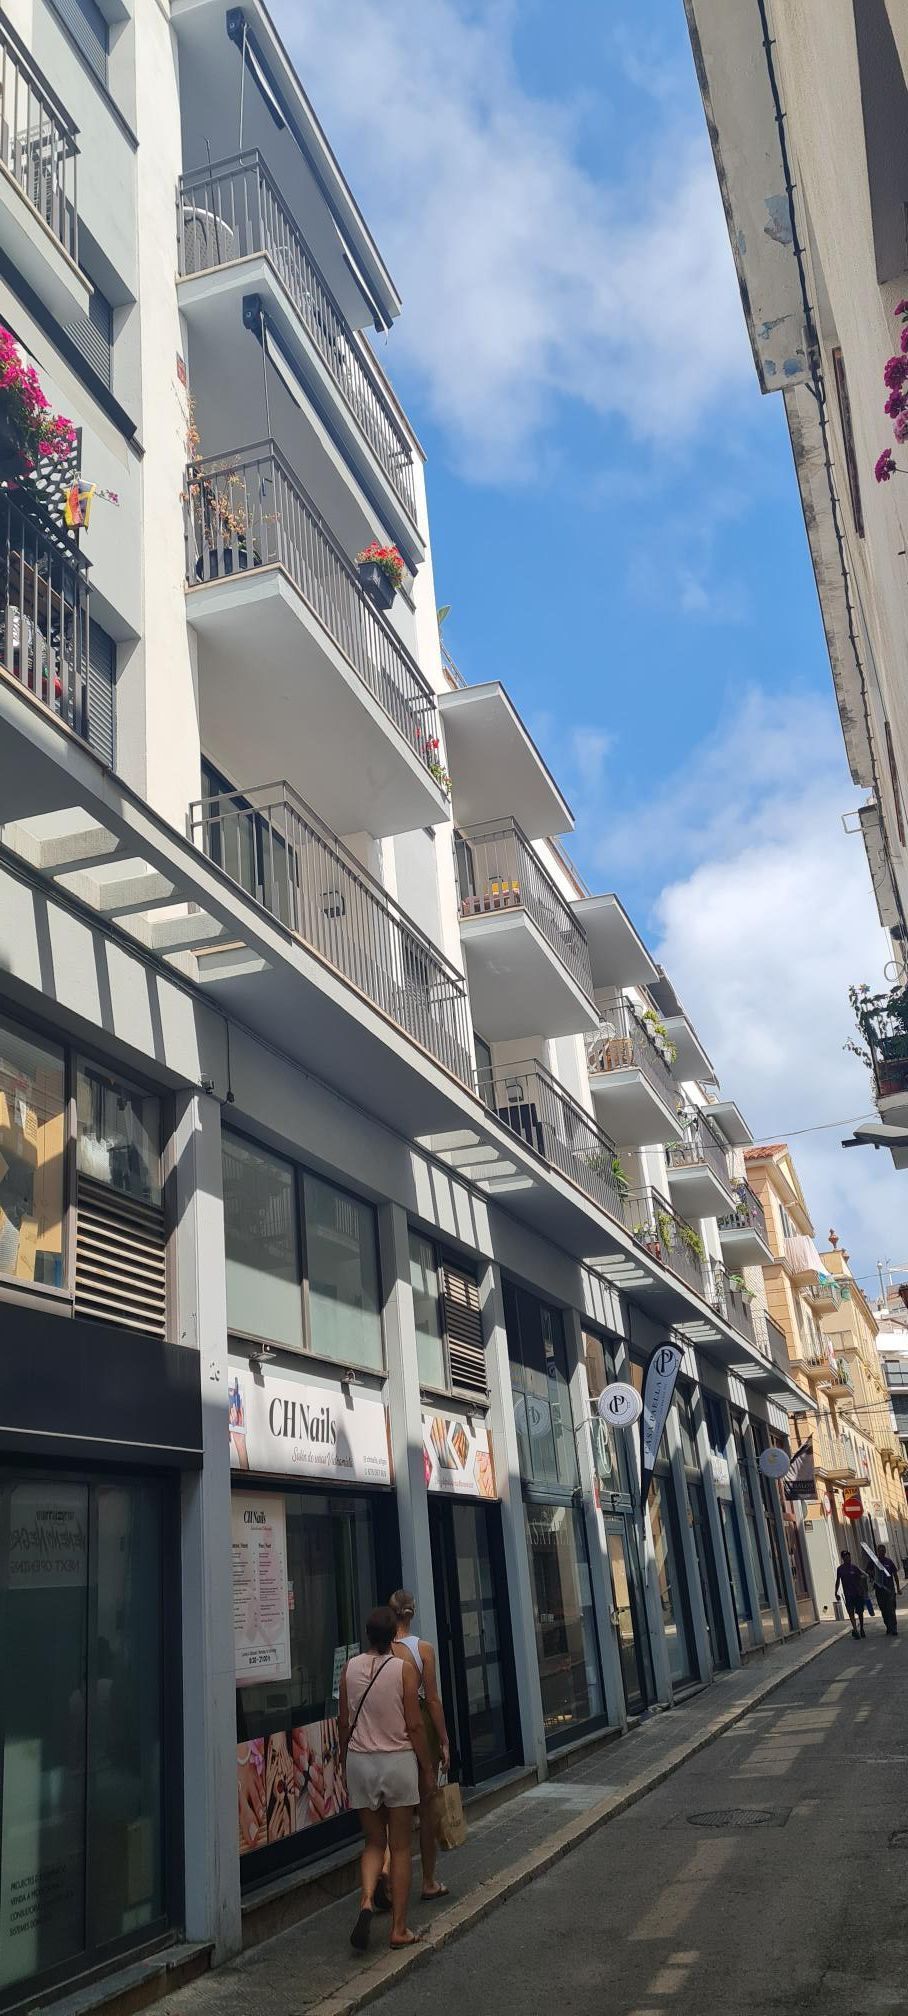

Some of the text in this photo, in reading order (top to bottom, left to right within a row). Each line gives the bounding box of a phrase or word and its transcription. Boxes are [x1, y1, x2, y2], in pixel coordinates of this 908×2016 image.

[269, 1398, 337, 1445] CH Nails
[649, 1382, 662, 1424] PAELLA
